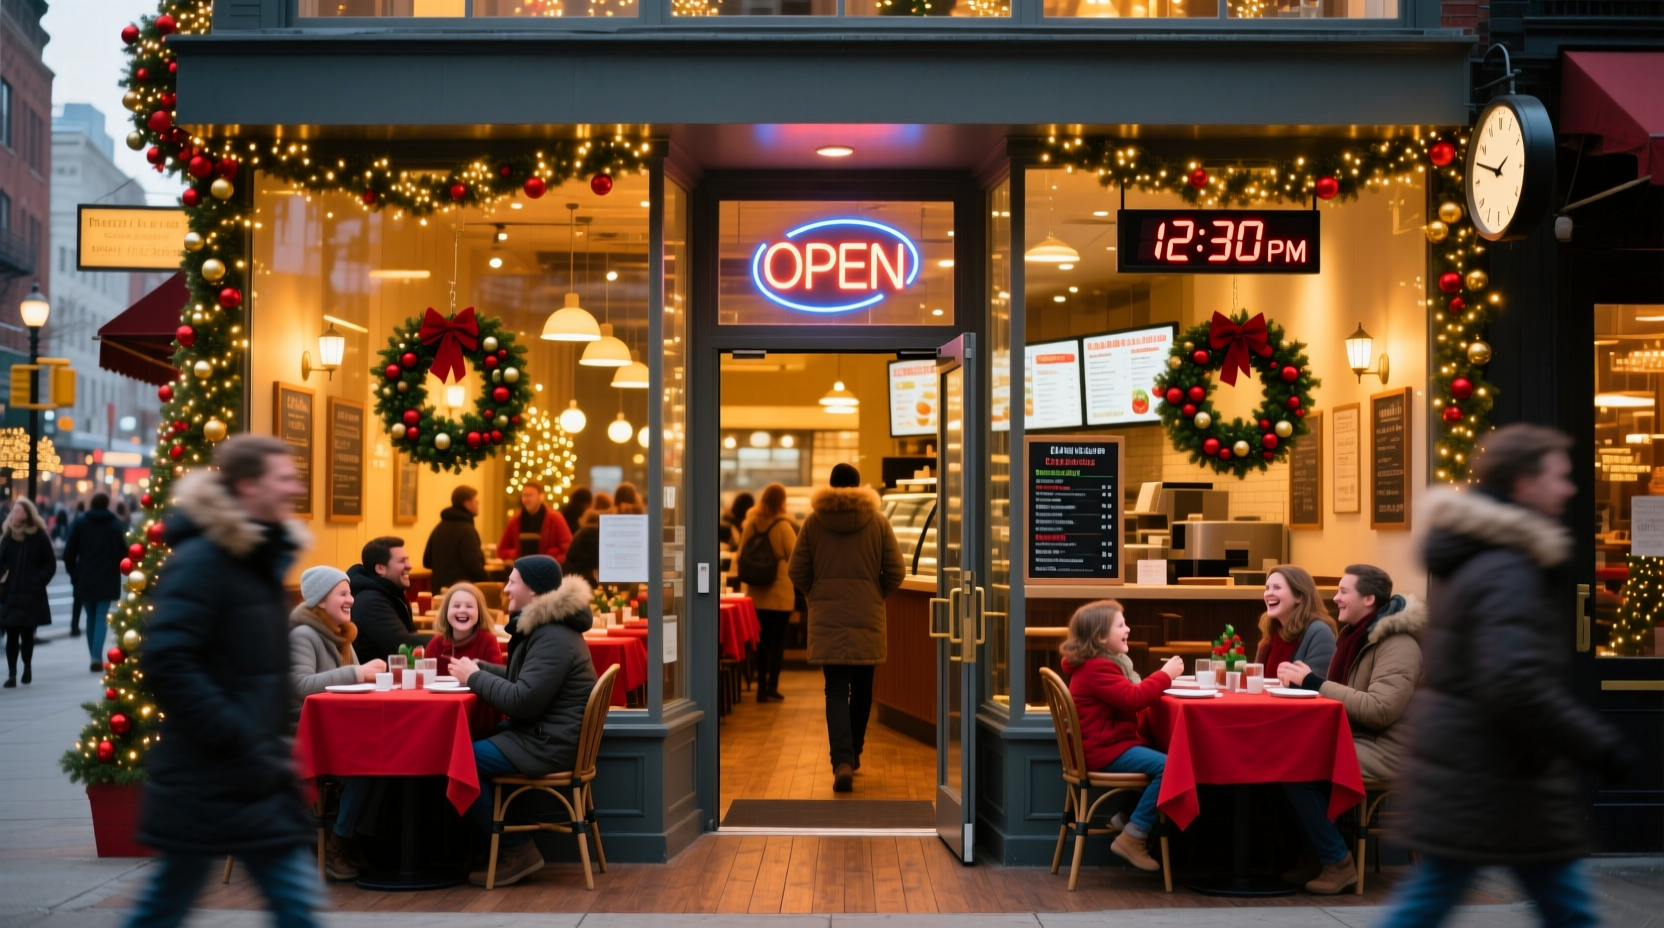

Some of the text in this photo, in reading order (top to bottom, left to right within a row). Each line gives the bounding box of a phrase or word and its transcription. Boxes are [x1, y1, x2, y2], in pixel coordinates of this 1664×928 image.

[1154, 220, 1306, 263] 12:30 PM
[764, 242, 904, 289] OPEN
